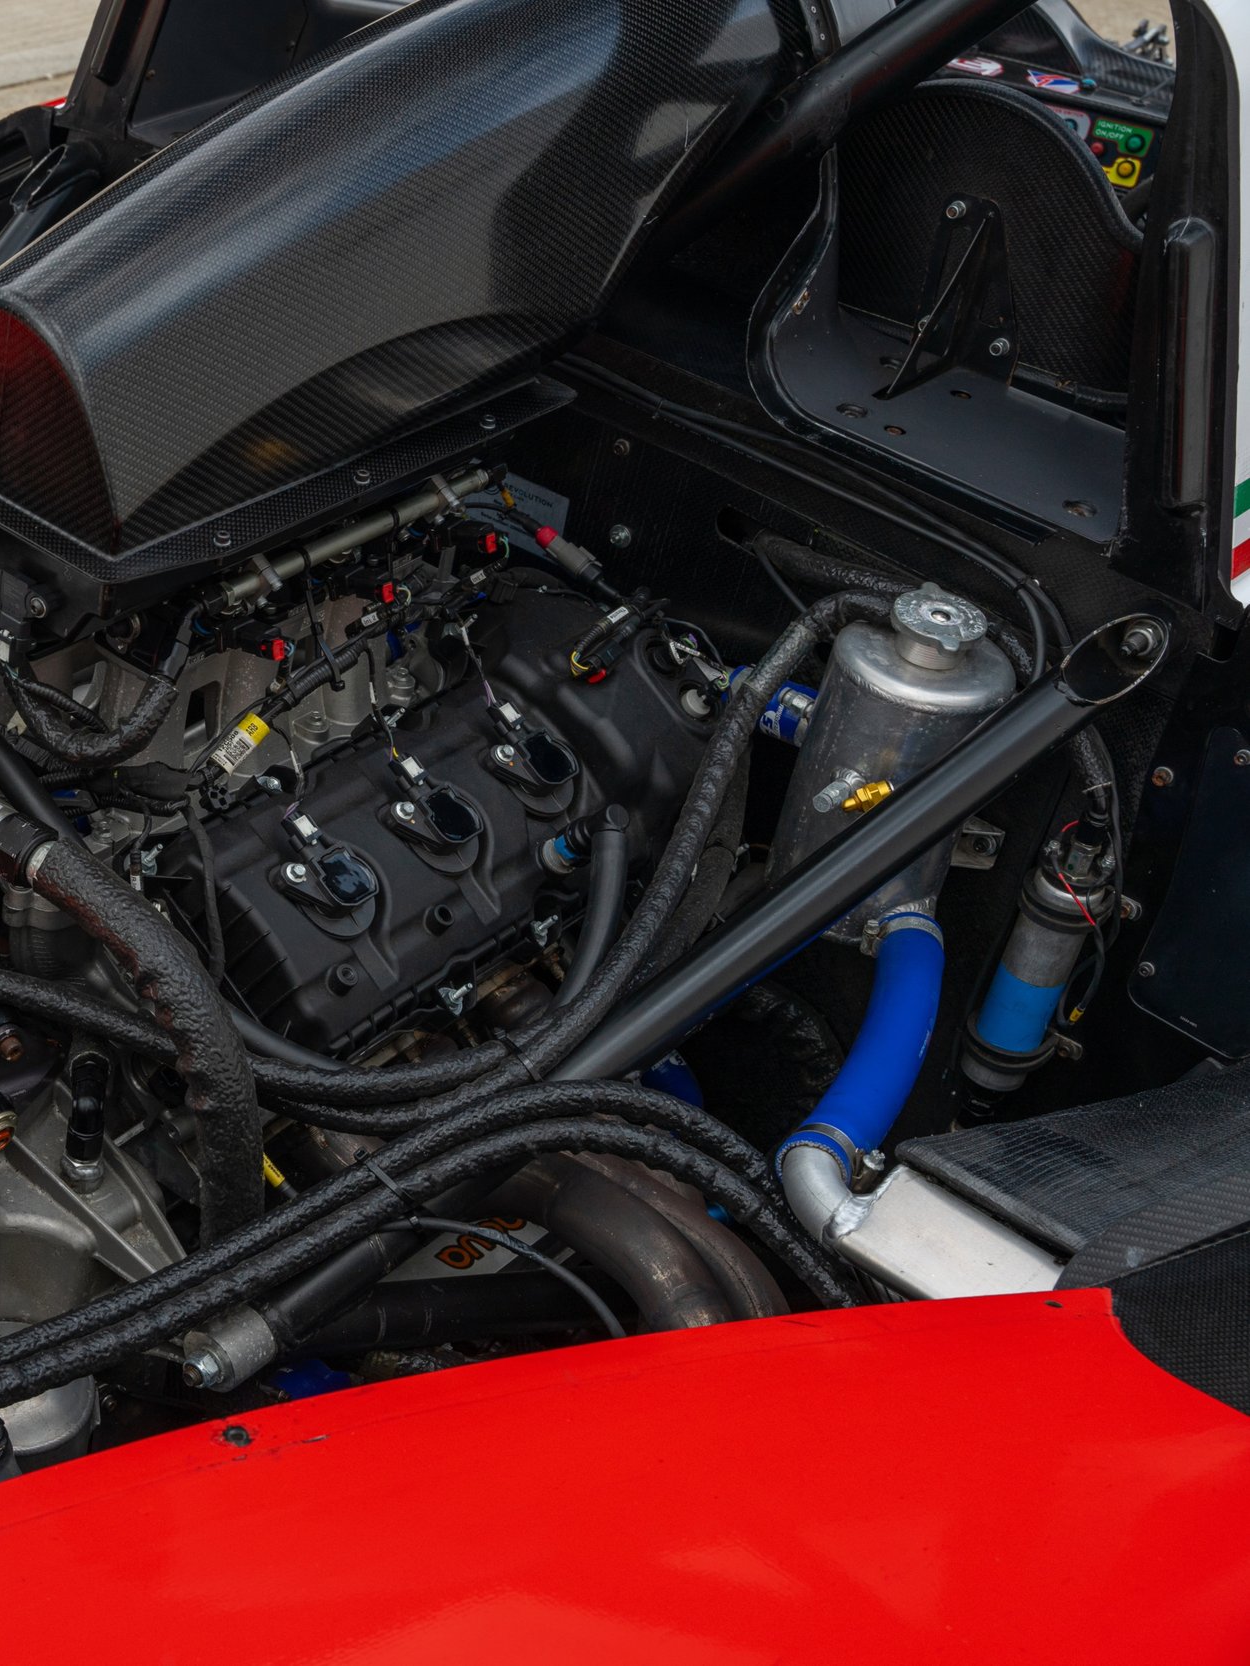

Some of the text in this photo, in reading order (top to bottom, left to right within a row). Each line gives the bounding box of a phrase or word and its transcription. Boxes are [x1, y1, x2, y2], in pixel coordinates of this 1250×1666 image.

[1097, 120, 1133, 134] IGNITION
[1094, 128, 1125, 141] ON/OFF
[245, 723, 259, 737] ARB
